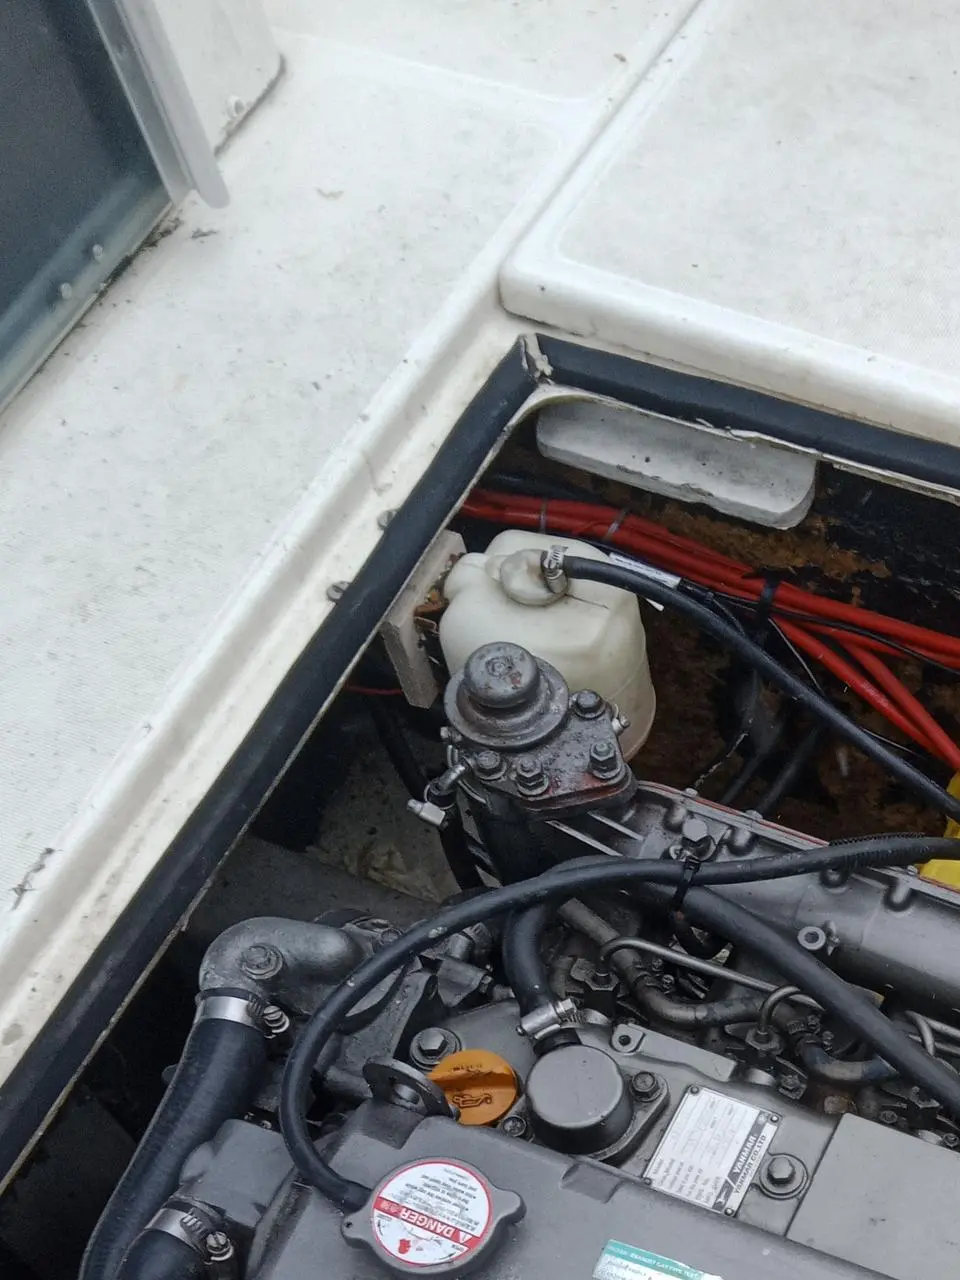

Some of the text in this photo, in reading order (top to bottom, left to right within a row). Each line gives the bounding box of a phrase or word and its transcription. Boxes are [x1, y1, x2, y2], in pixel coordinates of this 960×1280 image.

[733, 1134, 757, 1175] YANMAR
[736, 1161, 754, 1193] YANMAR
[400, 1208, 456, 1238] DANGER
